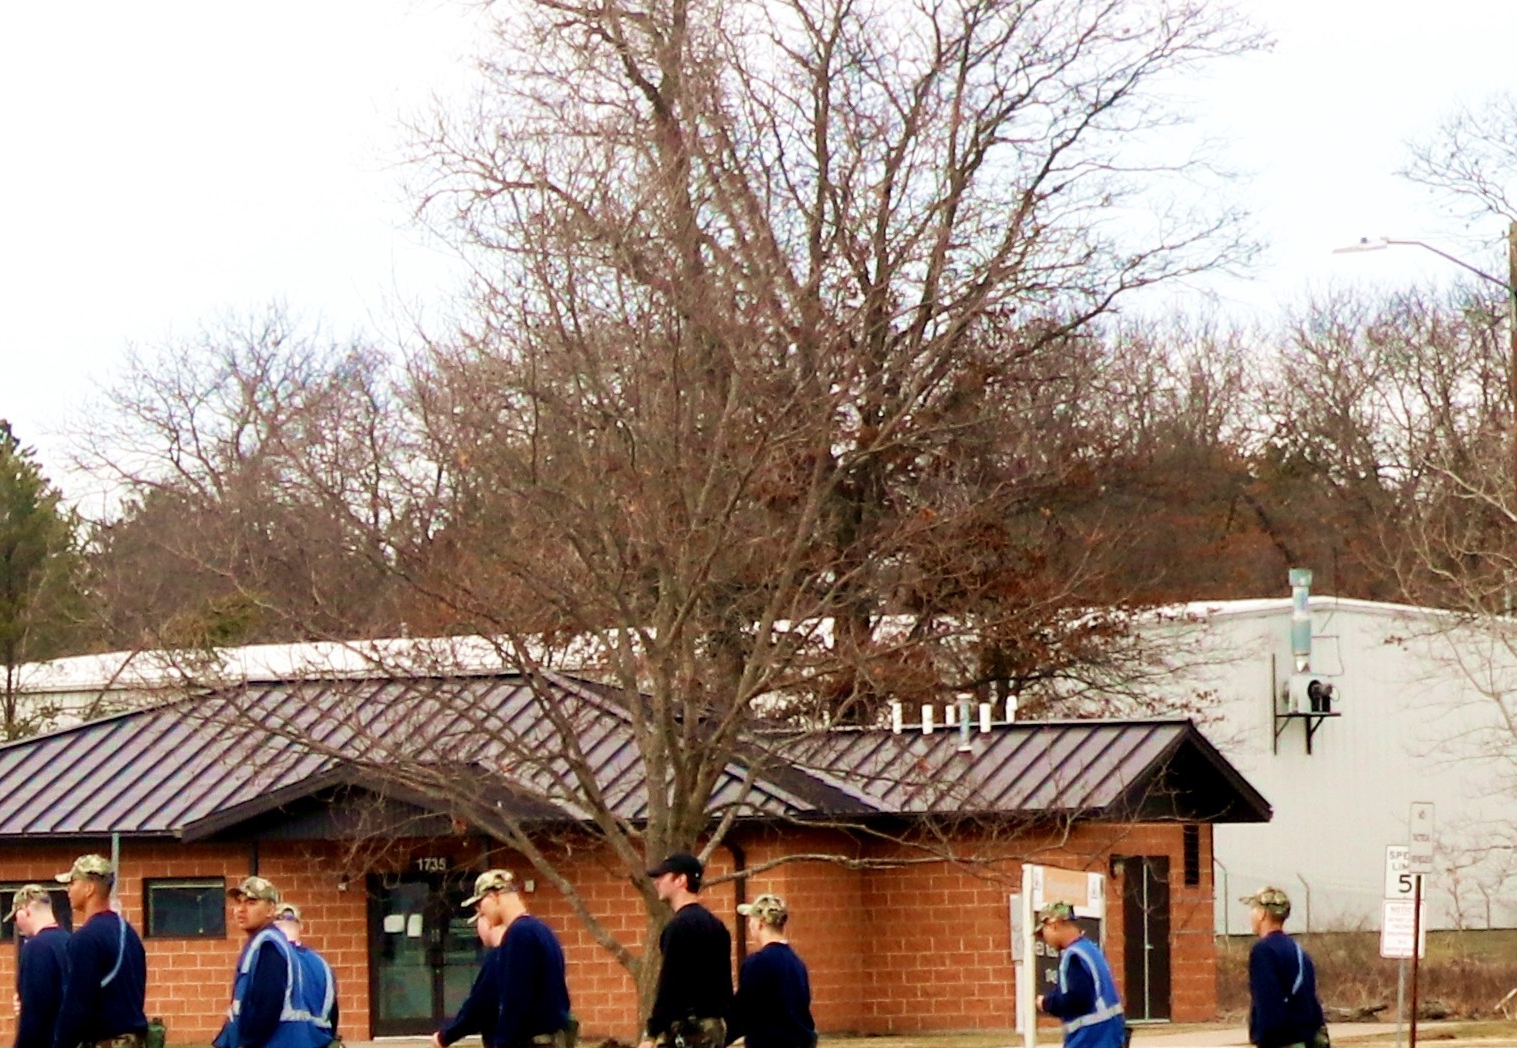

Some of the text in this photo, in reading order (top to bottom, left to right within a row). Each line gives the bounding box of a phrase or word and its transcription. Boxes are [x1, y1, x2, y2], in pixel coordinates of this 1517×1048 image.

[1389, 851, 1410, 861] SPE
[417, 857, 447, 872] 1735
[1392, 863, 1410, 872] LIM
[1398, 874, 1412, 893] 5
